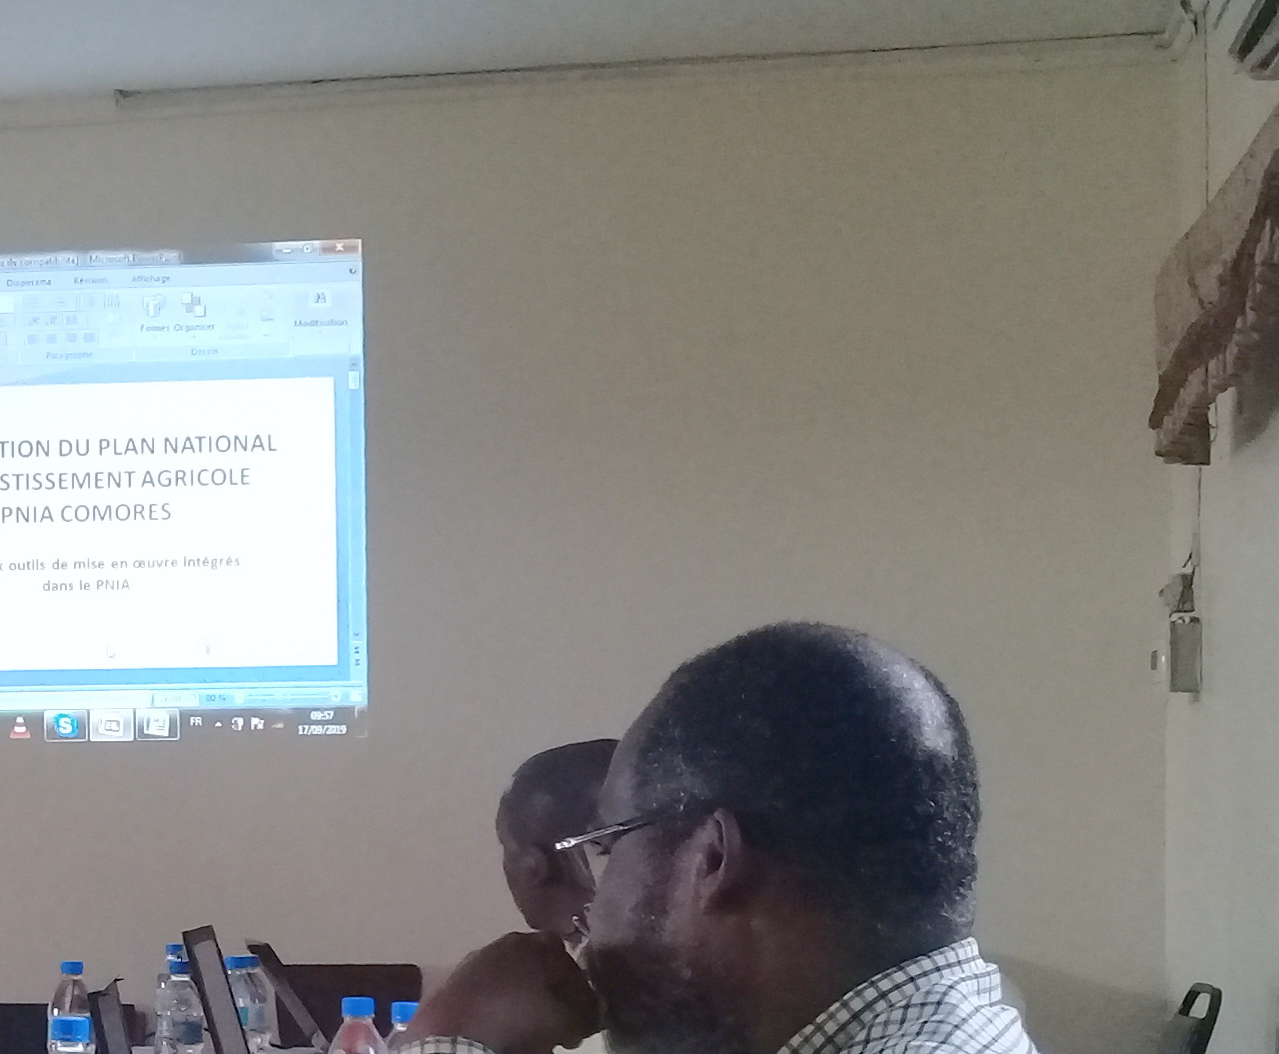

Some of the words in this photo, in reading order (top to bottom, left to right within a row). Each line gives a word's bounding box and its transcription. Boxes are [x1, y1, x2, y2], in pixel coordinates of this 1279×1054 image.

[58, 438, 90, 457] DU
[98, 437, 156, 456] PLAN
[164, 434, 278, 454] NATIONAL
[140, 467, 251, 488] AGRICOLE
[1, 505, 55, 524] PNIA
[60, 502, 172, 523] COMORES
[8, 558, 47, 571] outils
[51, 558, 68, 570] de
[73, 557, 105, 570] mise
[110, 559, 128, 569] en
[132, 557, 178, 569] œuvre
[42, 579, 74, 592] dans
[79, 579, 91, 591] le
[96, 578, 131, 591] PNIA
